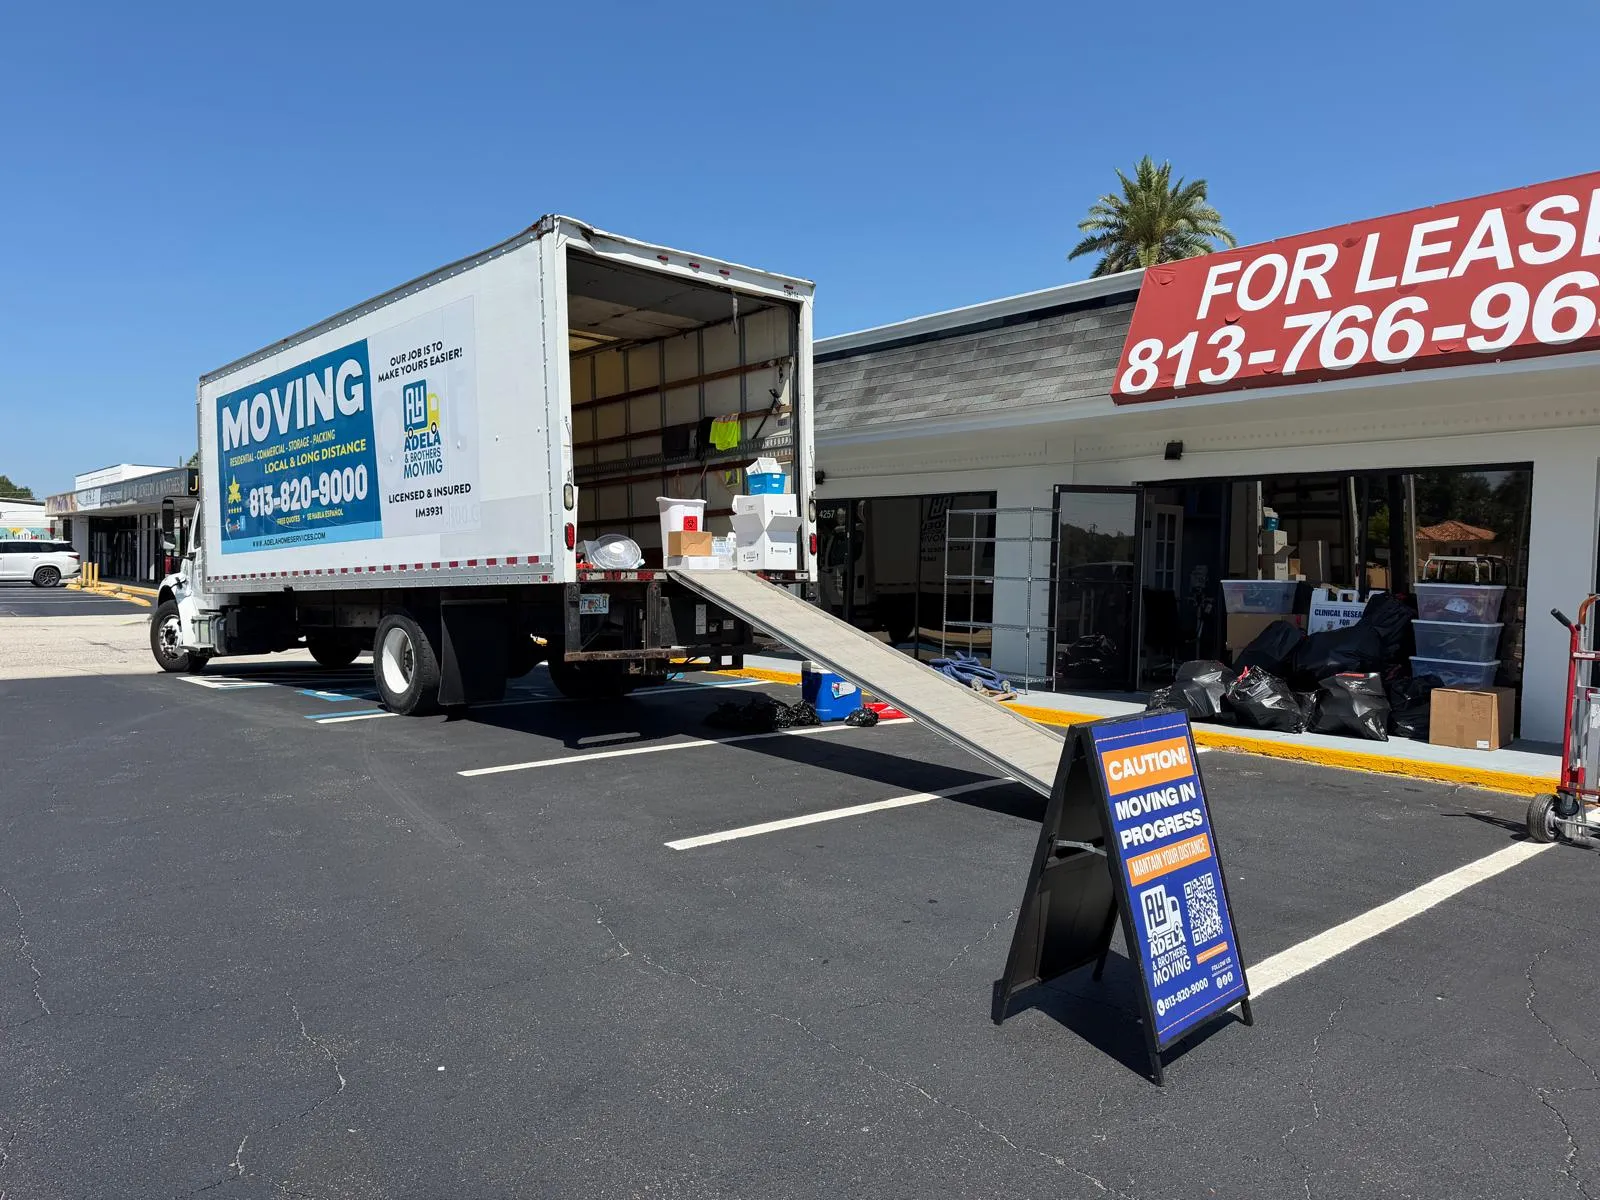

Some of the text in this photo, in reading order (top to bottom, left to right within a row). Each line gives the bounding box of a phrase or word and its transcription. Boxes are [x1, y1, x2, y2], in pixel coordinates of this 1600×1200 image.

[1196, 243, 1339, 320] FOR
[1120, 271, 1600, 395] 813-766-96
[378, 347, 463, 382] MAKE YOURS EASIER!
[390, 341, 443, 366] OUR JOB IS TO
[222, 359, 365, 452] MOVING
[229, 429, 336, 467] RESIDENTIAL COMMERCIAL STORAGE PACKING
[264, 438, 367, 474] LOCAL & LONG DISTANCE
[404, 430, 441, 452] ADELA
[410, 447, 441, 463] BROTHERS
[404, 458, 443, 479] MOVING
[249, 464, 368, 518] 813-820-9000
[388, 483, 472, 504] LICENSED & INSURED
[415, 506, 443, 518] IM3931
[819, 510, 835, 518] 4257
[1314, 608, 1364, 618] CLINICAL RESEA
[1108, 746, 1188, 781] CAUTION!
[1114, 781, 1197, 821] MOVING IN
[1120, 808, 1203, 850] PROGRESS
[1160, 844, 1181, 866] YOUR
[1178, 837, 1207, 861] DISTANCE
[1150, 928, 1187, 958] ADELA
[1152, 960, 1158, 971] &
[1157, 944, 1188, 969] BROTHERS
[1153, 955, 1192, 988] MOVING
[1211, 958, 1227, 972] FOLLOW
[1225, 956, 1232, 965] US
[1163, 977, 1209, 1010] 813-820-9000
